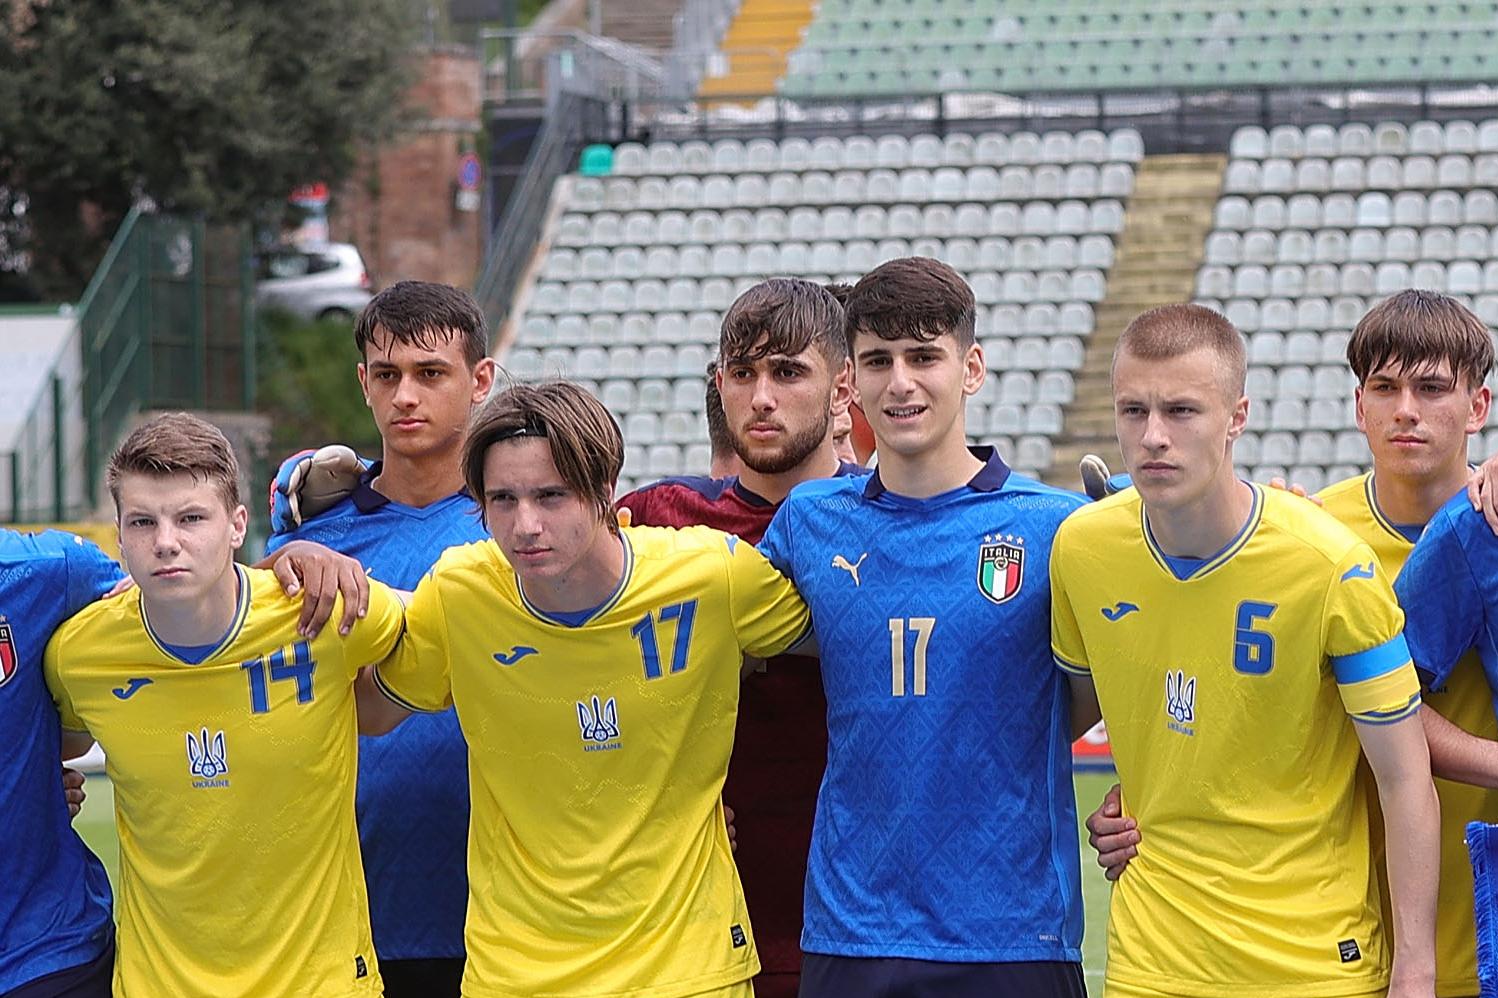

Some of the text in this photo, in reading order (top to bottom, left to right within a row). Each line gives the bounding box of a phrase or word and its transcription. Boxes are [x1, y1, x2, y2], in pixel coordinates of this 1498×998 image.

[984, 547, 1020, 560] ITALIA
[631, 599, 699, 680] 17
[889, 617, 936, 696] 17
[1232, 599, 1278, 676] 6
[240, 639, 318, 713] 14
[584, 742, 622, 752] UKRAINE
